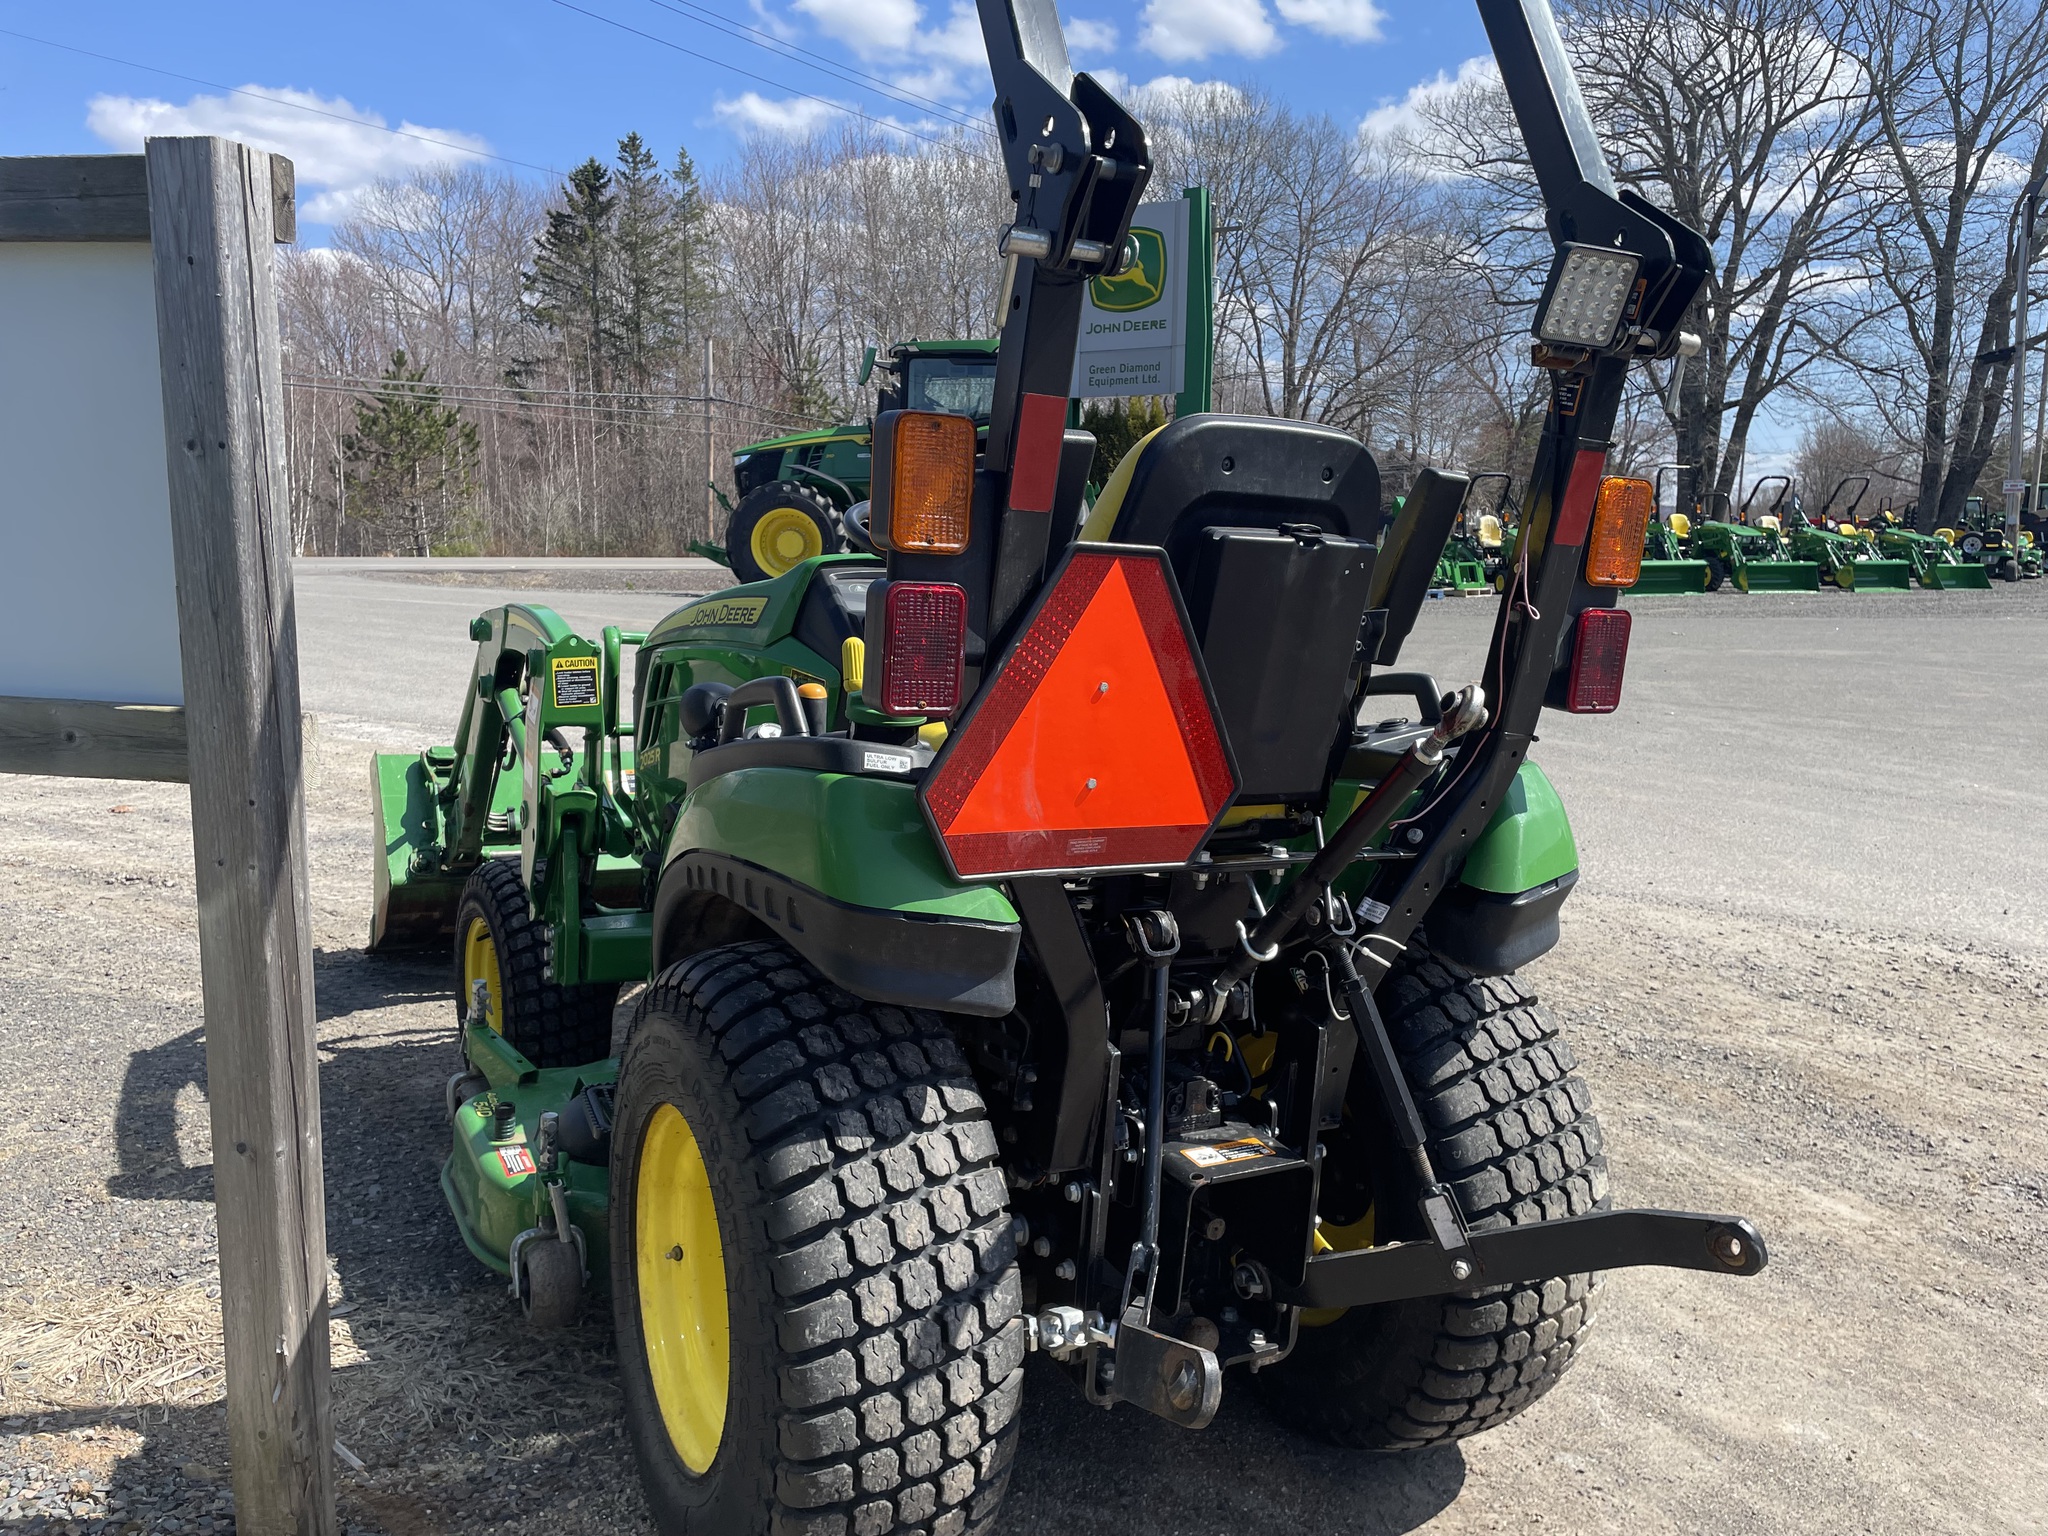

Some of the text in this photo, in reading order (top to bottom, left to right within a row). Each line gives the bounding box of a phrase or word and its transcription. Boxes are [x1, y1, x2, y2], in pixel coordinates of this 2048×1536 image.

[1085, 319, 1168, 335] JOHN DEERE
[1089, 362, 1161, 375] Green Diamond
[1088, 374, 1161, 388] Equipment Ltd.
[690, 604, 757, 624] JOHN DEERE
[564, 659, 595, 668] CAUTION
